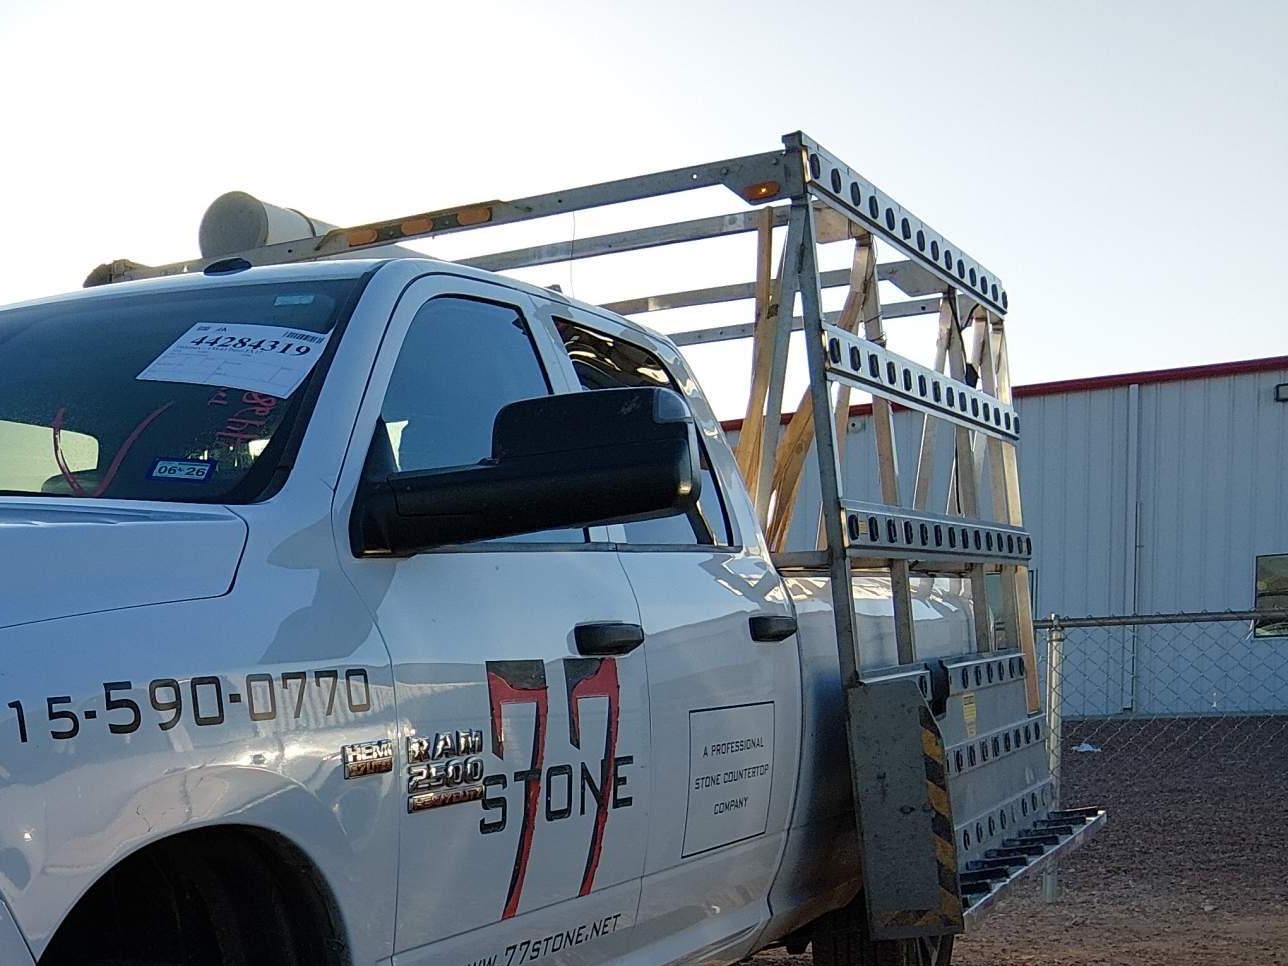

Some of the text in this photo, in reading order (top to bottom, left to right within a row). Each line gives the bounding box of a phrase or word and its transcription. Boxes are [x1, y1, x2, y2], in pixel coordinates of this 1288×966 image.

[190, 335, 311, 356] 44284319
[158, 465, 206, 477] 06 26
[407, 730, 482, 764] RAM
[702, 737, 764, 758] A PROFESSIONAL
[408, 756, 484, 794] 2500
[694, 763, 769, 790] STONE COUNTERTOP
[479, 755, 634, 835] STONE
[485, 657, 620, 921] 77
[713, 796, 749, 815] COMPANY
